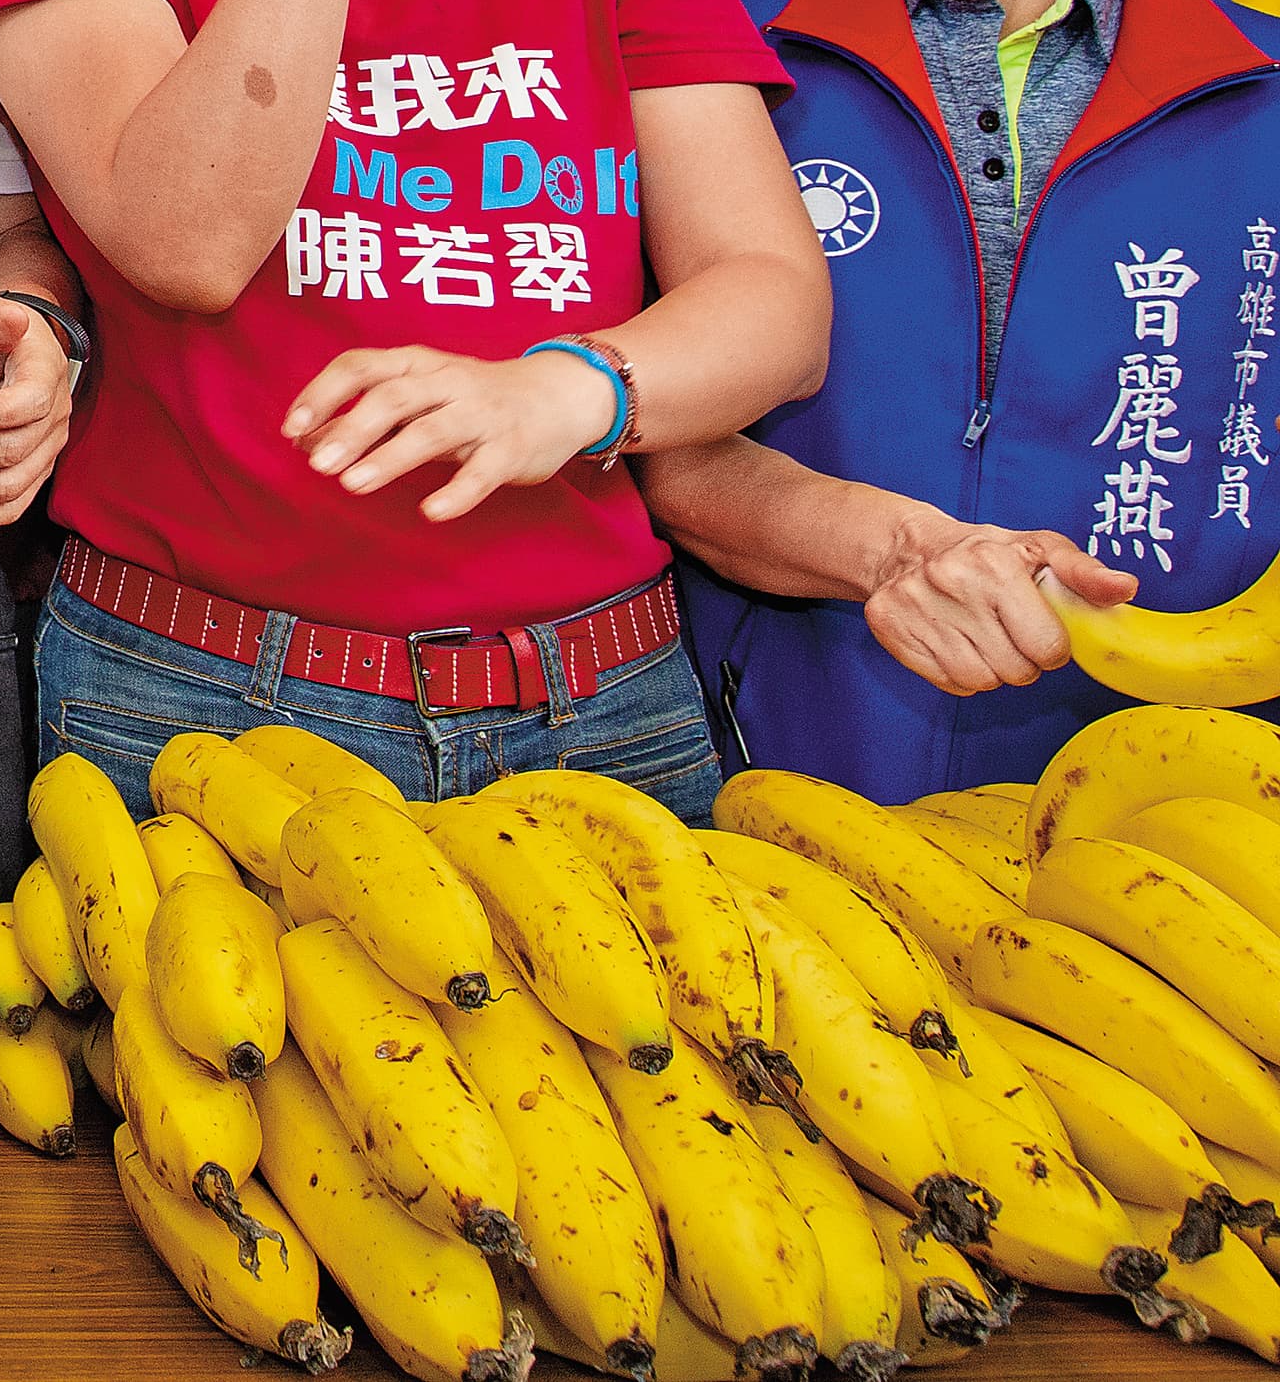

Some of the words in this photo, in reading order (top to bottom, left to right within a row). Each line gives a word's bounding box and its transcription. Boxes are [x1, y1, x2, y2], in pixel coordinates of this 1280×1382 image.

[286, 207, 591, 312] 陳若翠
[332, 138, 453, 213] Me
[1088, 241, 1201, 572] 曾麗燕
[1208, 217, 1278, 529] 高雄市議員
